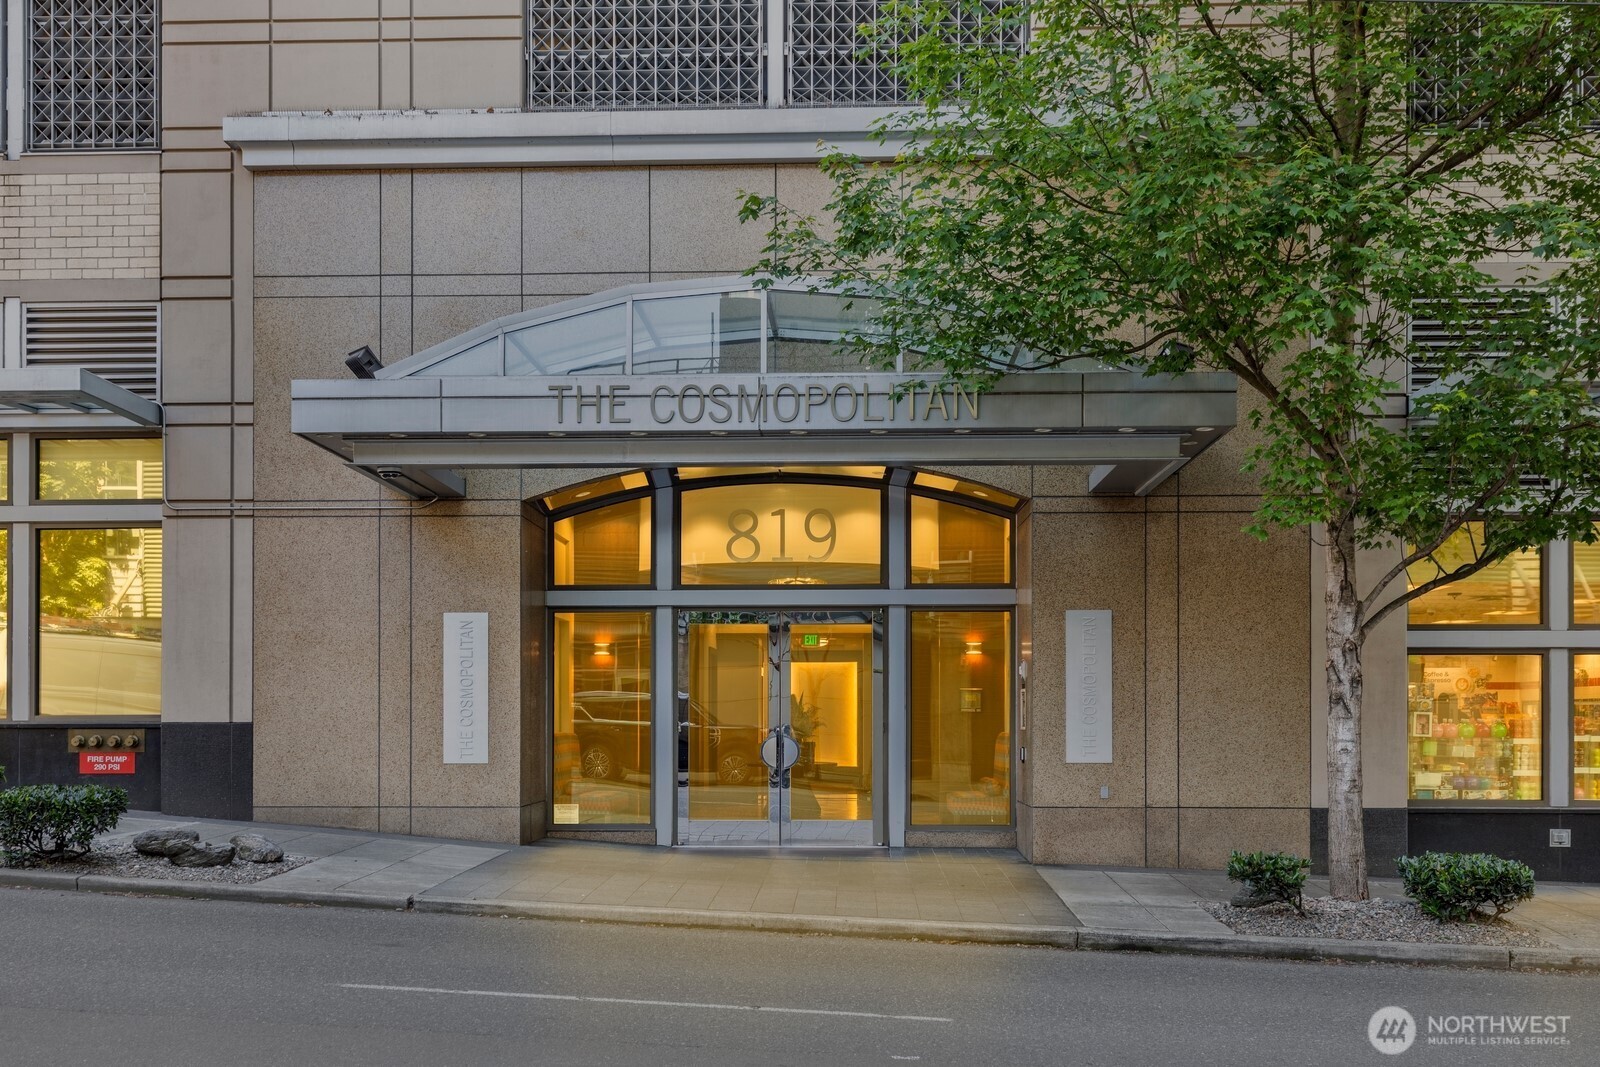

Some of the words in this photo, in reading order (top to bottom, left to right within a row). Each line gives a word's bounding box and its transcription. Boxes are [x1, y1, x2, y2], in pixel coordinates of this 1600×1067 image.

[548, 384, 632, 424] THE
[650, 382, 979, 424] COSMOPOLITAN
[726, 508, 837, 564] 819
[804, 635, 818, 645] EXIT
[460, 620, 474, 727] COSMOPOLITAN
[1082, 616, 1097, 725] COSMOPOLITAN
[460, 730, 474, 759] THE
[1082, 729, 1097, 758] THE
